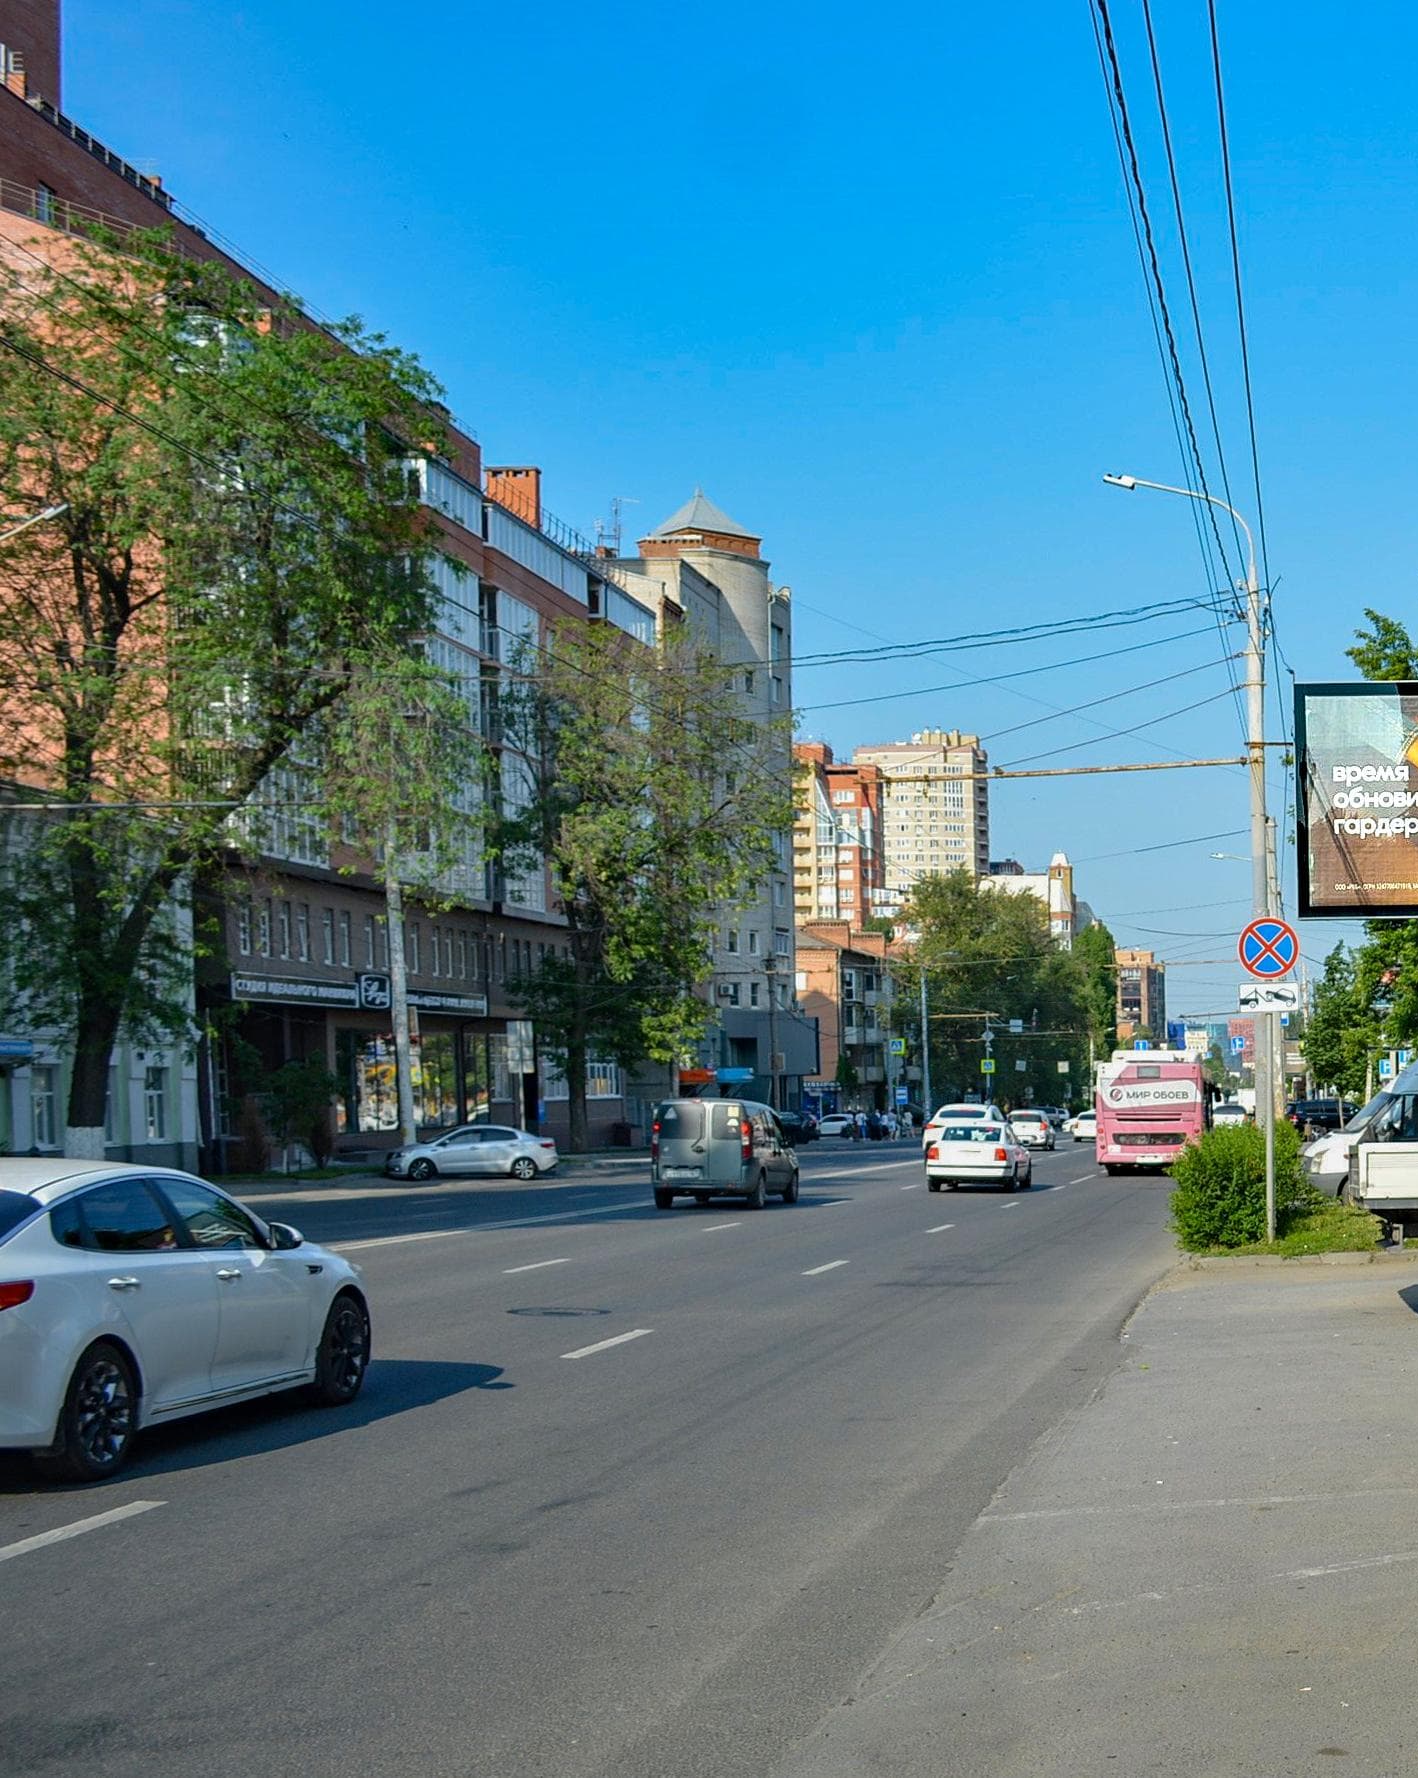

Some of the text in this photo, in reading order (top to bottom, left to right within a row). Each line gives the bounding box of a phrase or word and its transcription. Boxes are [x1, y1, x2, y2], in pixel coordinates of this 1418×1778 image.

[1332, 765, 1410, 787] время
[1126, 1090, 1189, 1099] МИР ОБОЕВ
